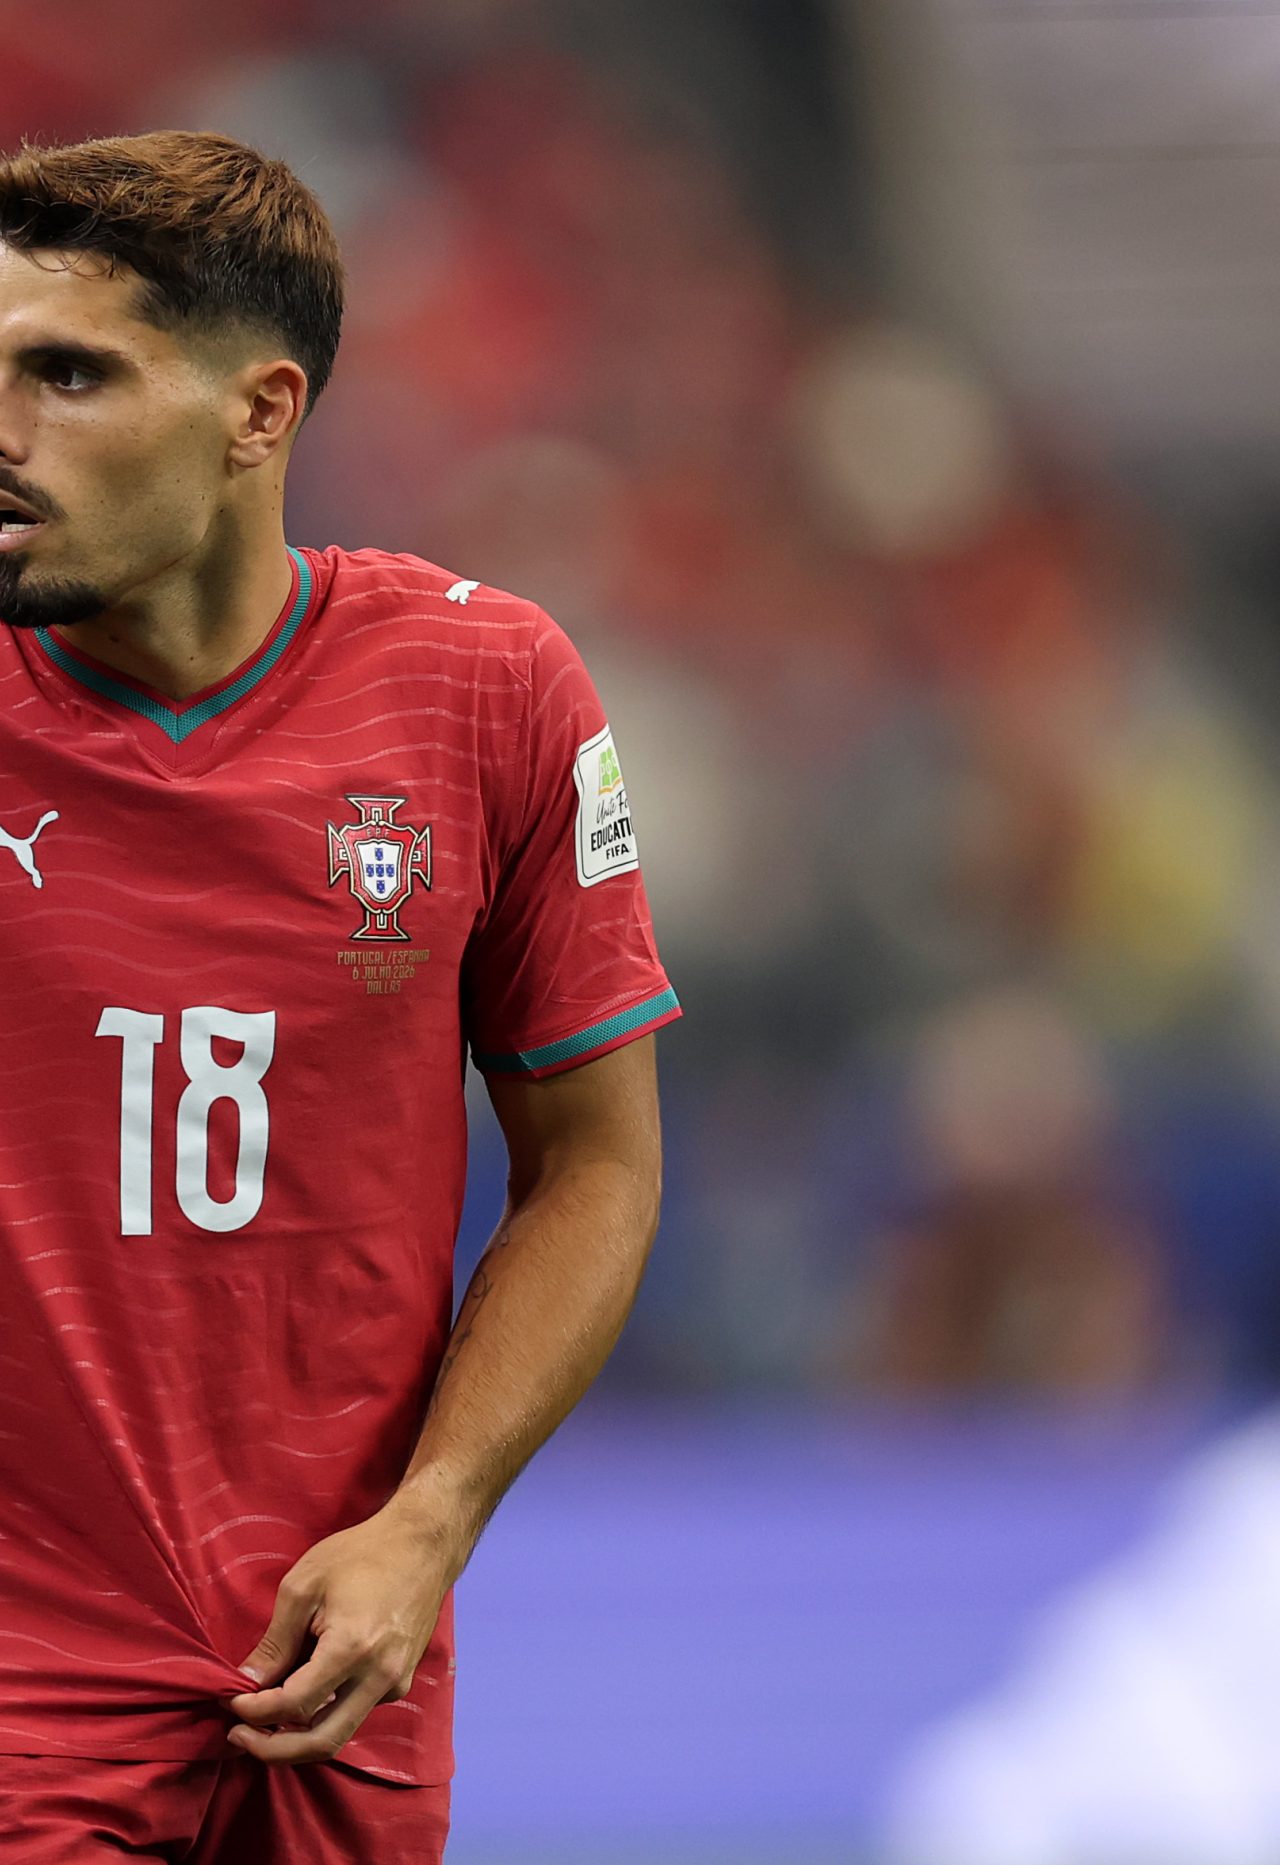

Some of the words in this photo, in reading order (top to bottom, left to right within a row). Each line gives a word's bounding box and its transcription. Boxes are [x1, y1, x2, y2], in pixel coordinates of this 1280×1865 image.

[591, 816, 633, 852] EDUCATI
[606, 843, 630, 860] FIFA
[352, 966, 359, 980] 6
[361, 965, 392, 979] JULHO
[393, 964, 416, 979] 2026
[366, 980, 401, 994] DALLAS
[94, 1005, 276, 1236] 18
